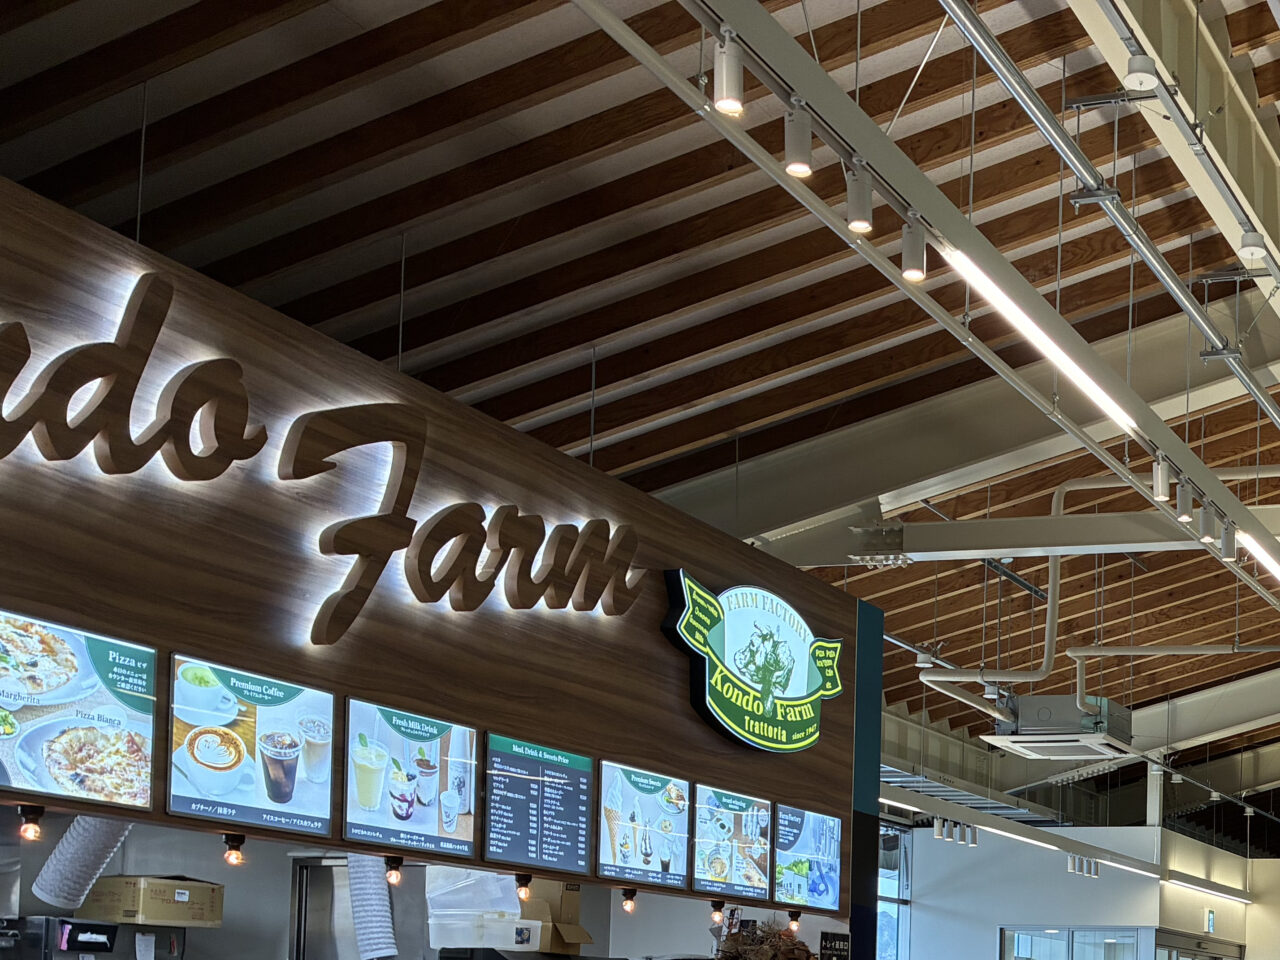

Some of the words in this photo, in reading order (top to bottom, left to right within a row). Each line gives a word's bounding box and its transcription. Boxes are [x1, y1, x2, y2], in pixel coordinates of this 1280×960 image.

[278, 402, 650, 646] Farm
[726, 592, 759, 612] FARM
[761, 594, 811, 643] FACTORY
[108, 650, 136, 667] Pizza
[230, 677, 262, 692] Premium
[262, 685, 285, 698] Coffee
[709, 665, 764, 717] Kondo
[776, 702, 815, 722] Farm
[75, 710, 95, 721] Pizza
[97, 714, 121, 727] Bianca
[744, 715, 787, 743] Trattoria
